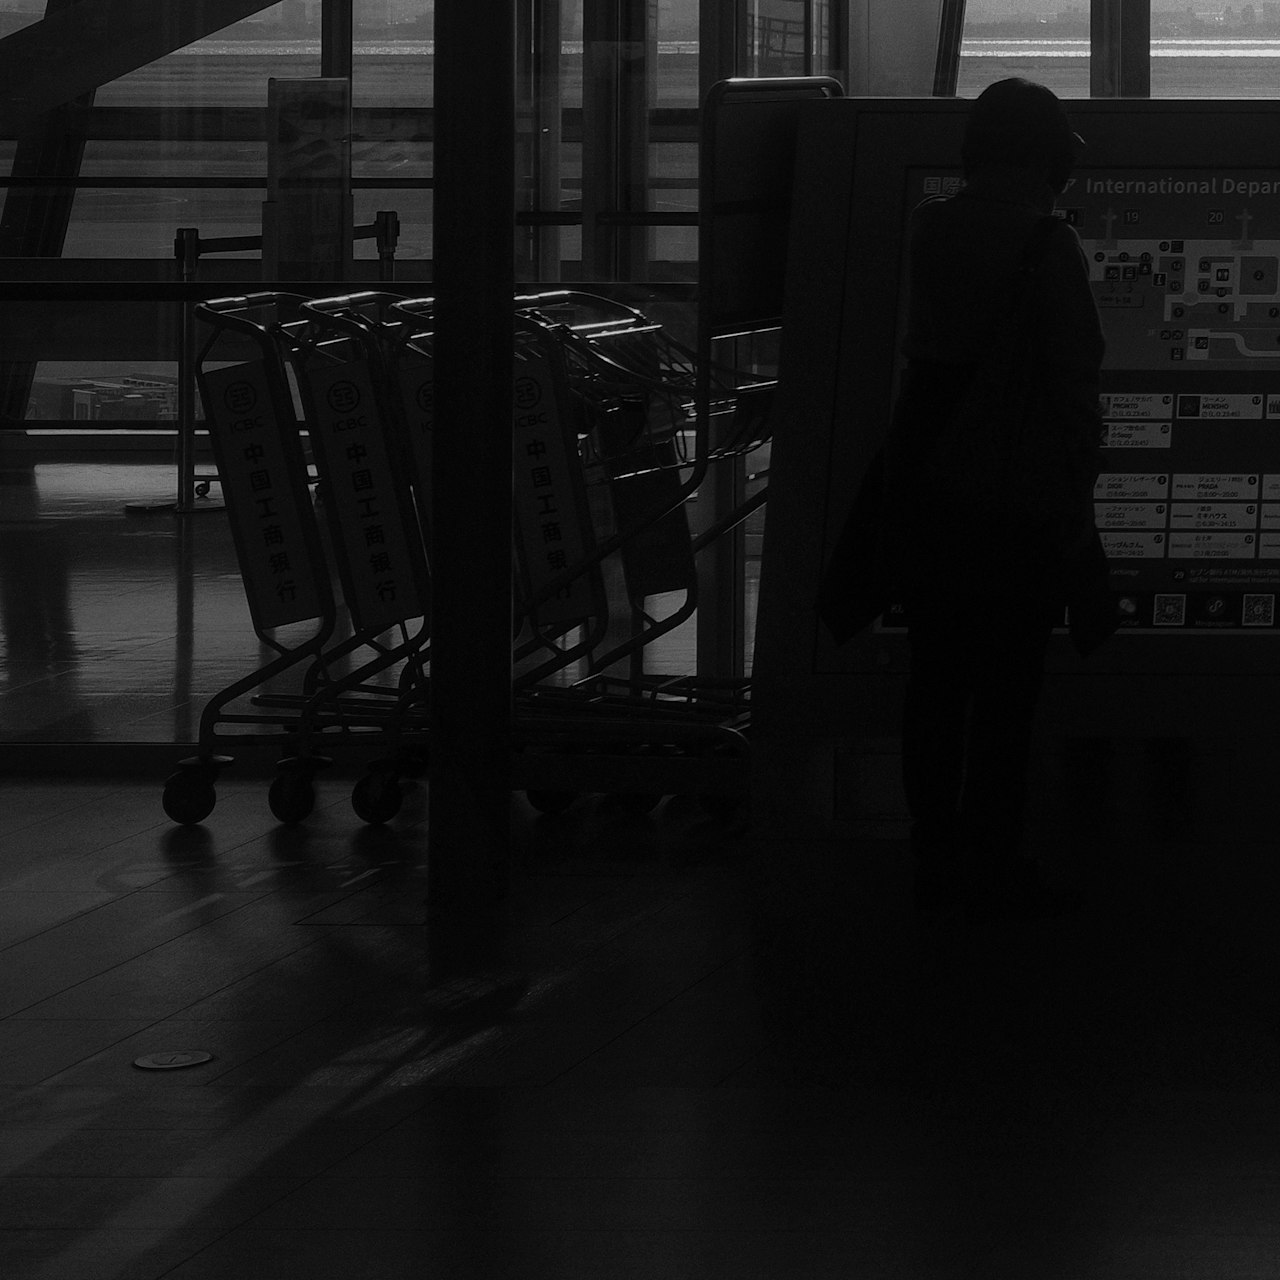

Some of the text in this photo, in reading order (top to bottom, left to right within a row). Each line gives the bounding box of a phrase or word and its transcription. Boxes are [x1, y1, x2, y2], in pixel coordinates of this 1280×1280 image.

[1086, 177, 1217, 195] International
[1126, 211, 1140, 222] 19
[1208, 211, 1224, 223] 20
[229, 415, 264, 433] ICBC
[332, 415, 368, 433] ICBC
[244, 441, 297, 603] 中国工商银行
[346, 441, 397, 603] 中国工商银行
